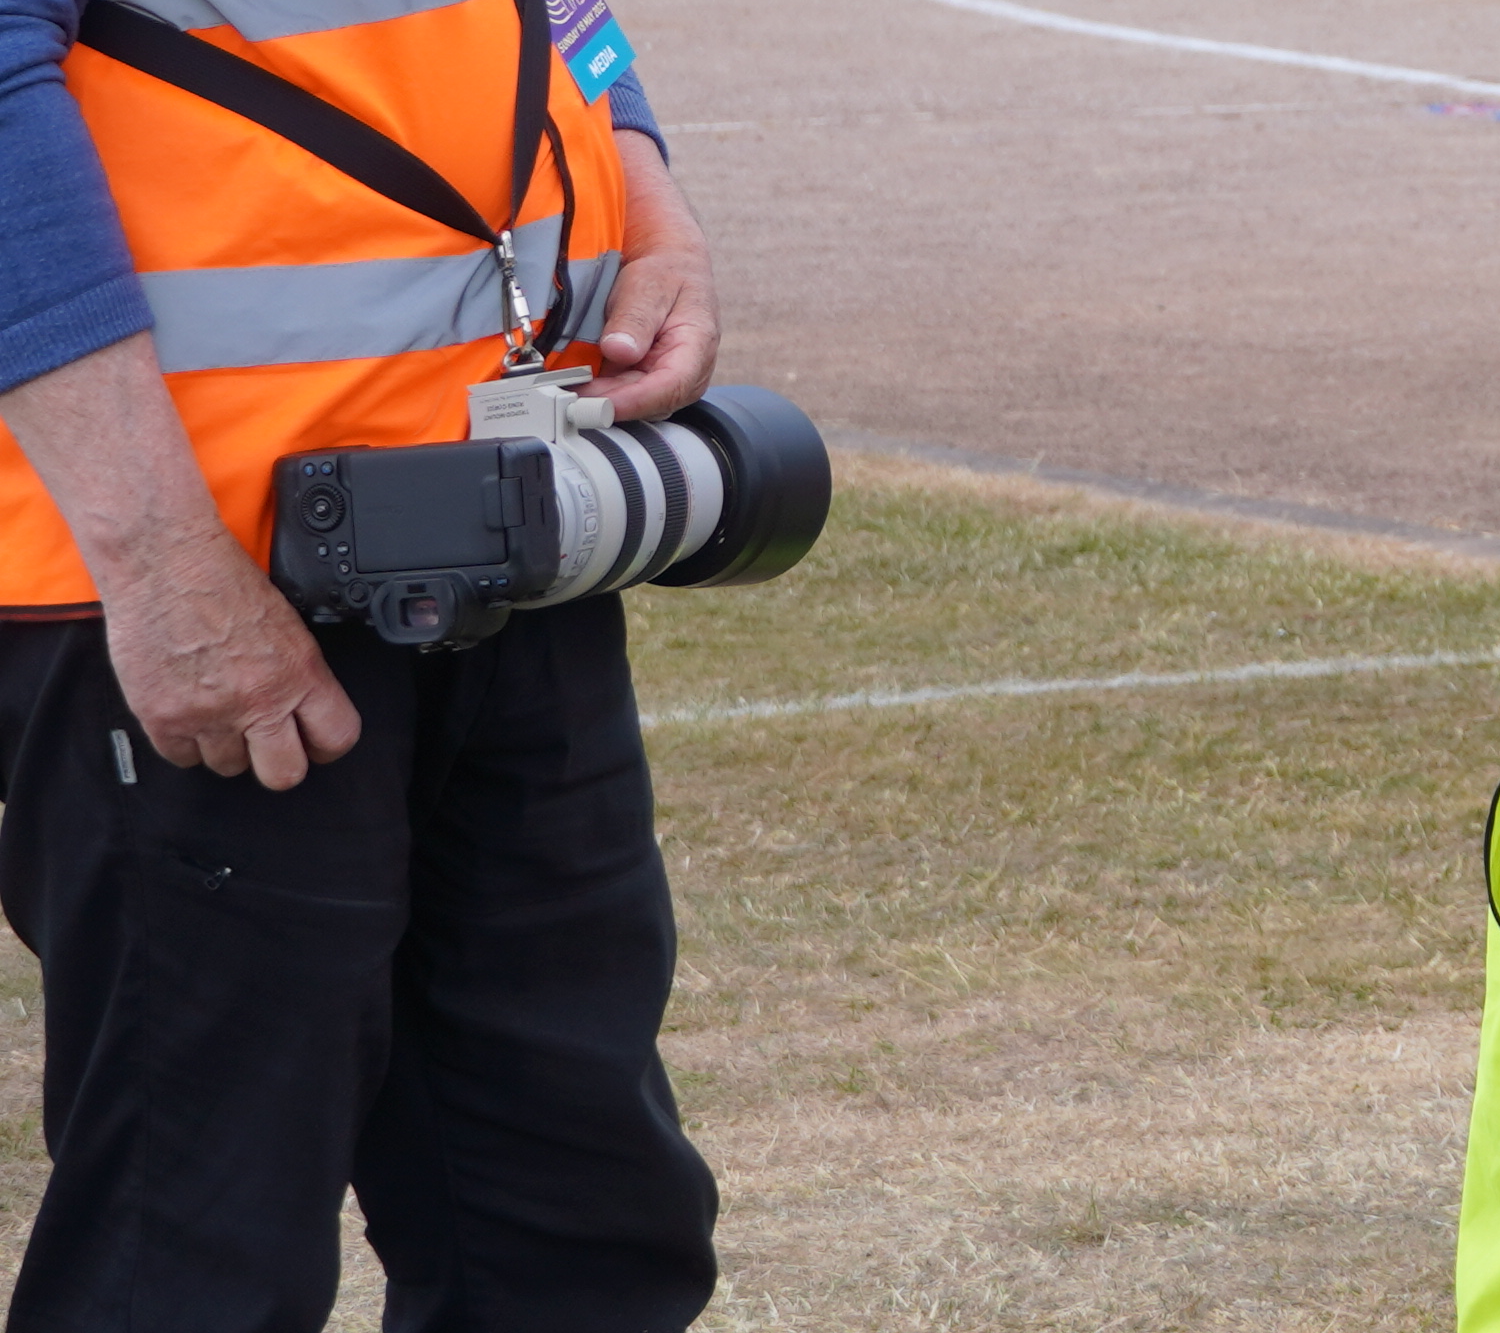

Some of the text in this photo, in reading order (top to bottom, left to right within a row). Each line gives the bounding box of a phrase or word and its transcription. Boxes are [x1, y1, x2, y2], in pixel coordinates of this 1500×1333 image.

[557, 25, 580, 53] SUNDAY
[582, 10, 597, 28] MAY
[587, 44, 619, 79] MEDIA
